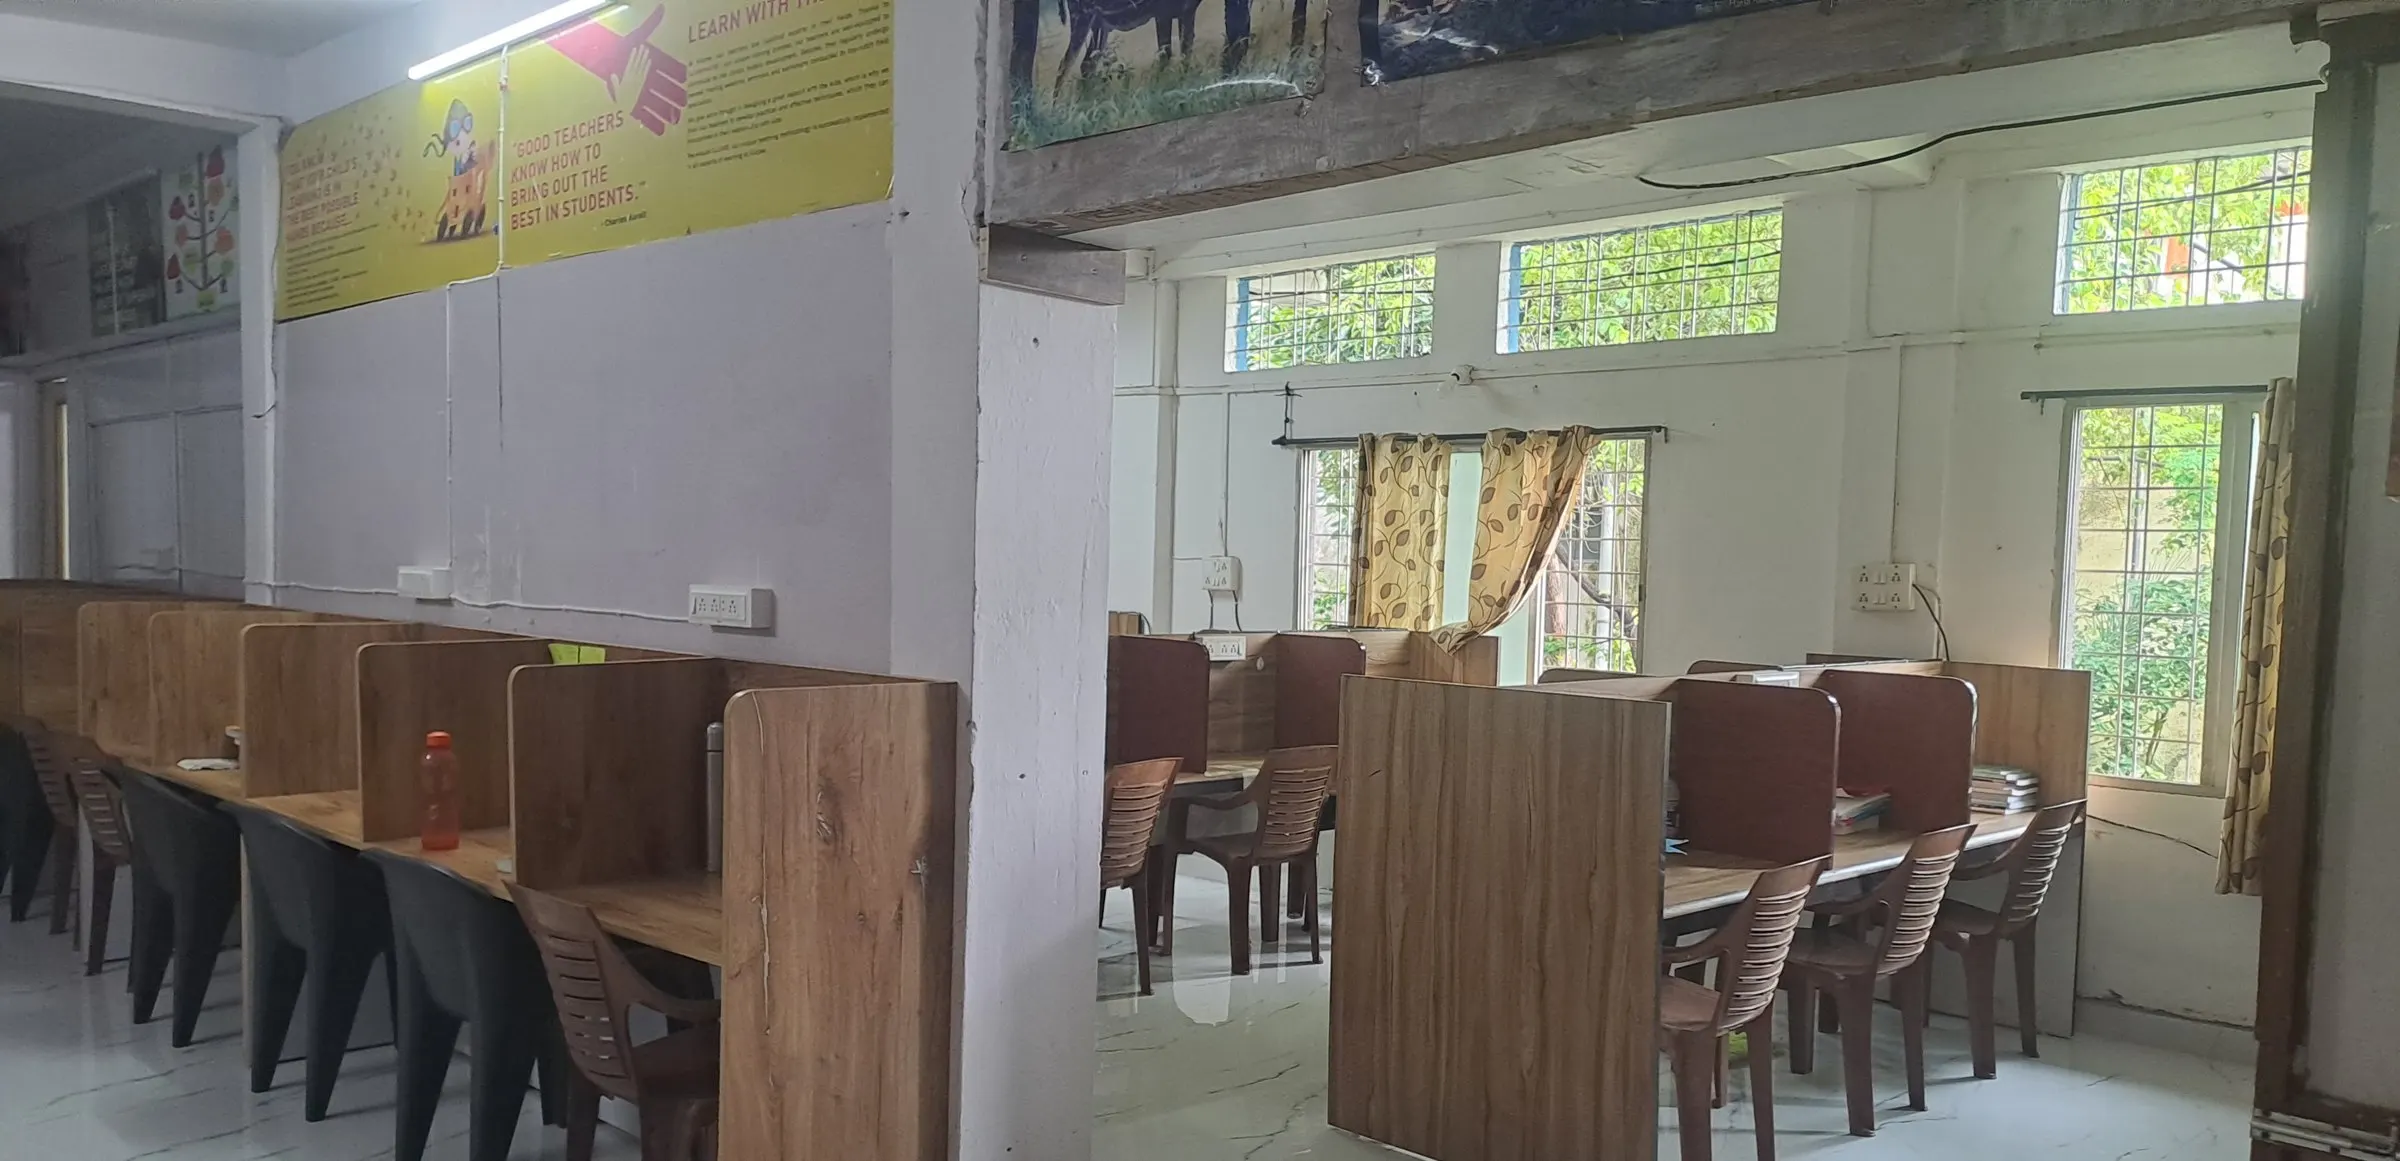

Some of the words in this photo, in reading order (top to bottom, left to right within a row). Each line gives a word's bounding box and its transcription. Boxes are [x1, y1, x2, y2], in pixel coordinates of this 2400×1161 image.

[688, 9, 740, 43] LEARN
[746, 0, 788, 24] WITH
[554, 110, 624, 147] TEACHERS
[511, 157, 548, 184] KNOW
[551, 149, 581, 172] HOW
[585, 142, 601, 162] TO
[511, 182, 549, 207] BRING
[553, 173, 578, 196] OUT
[582, 164, 608, 188] THE
[511, 207, 542, 230] BEST
[545, 203, 559, 222] IN
